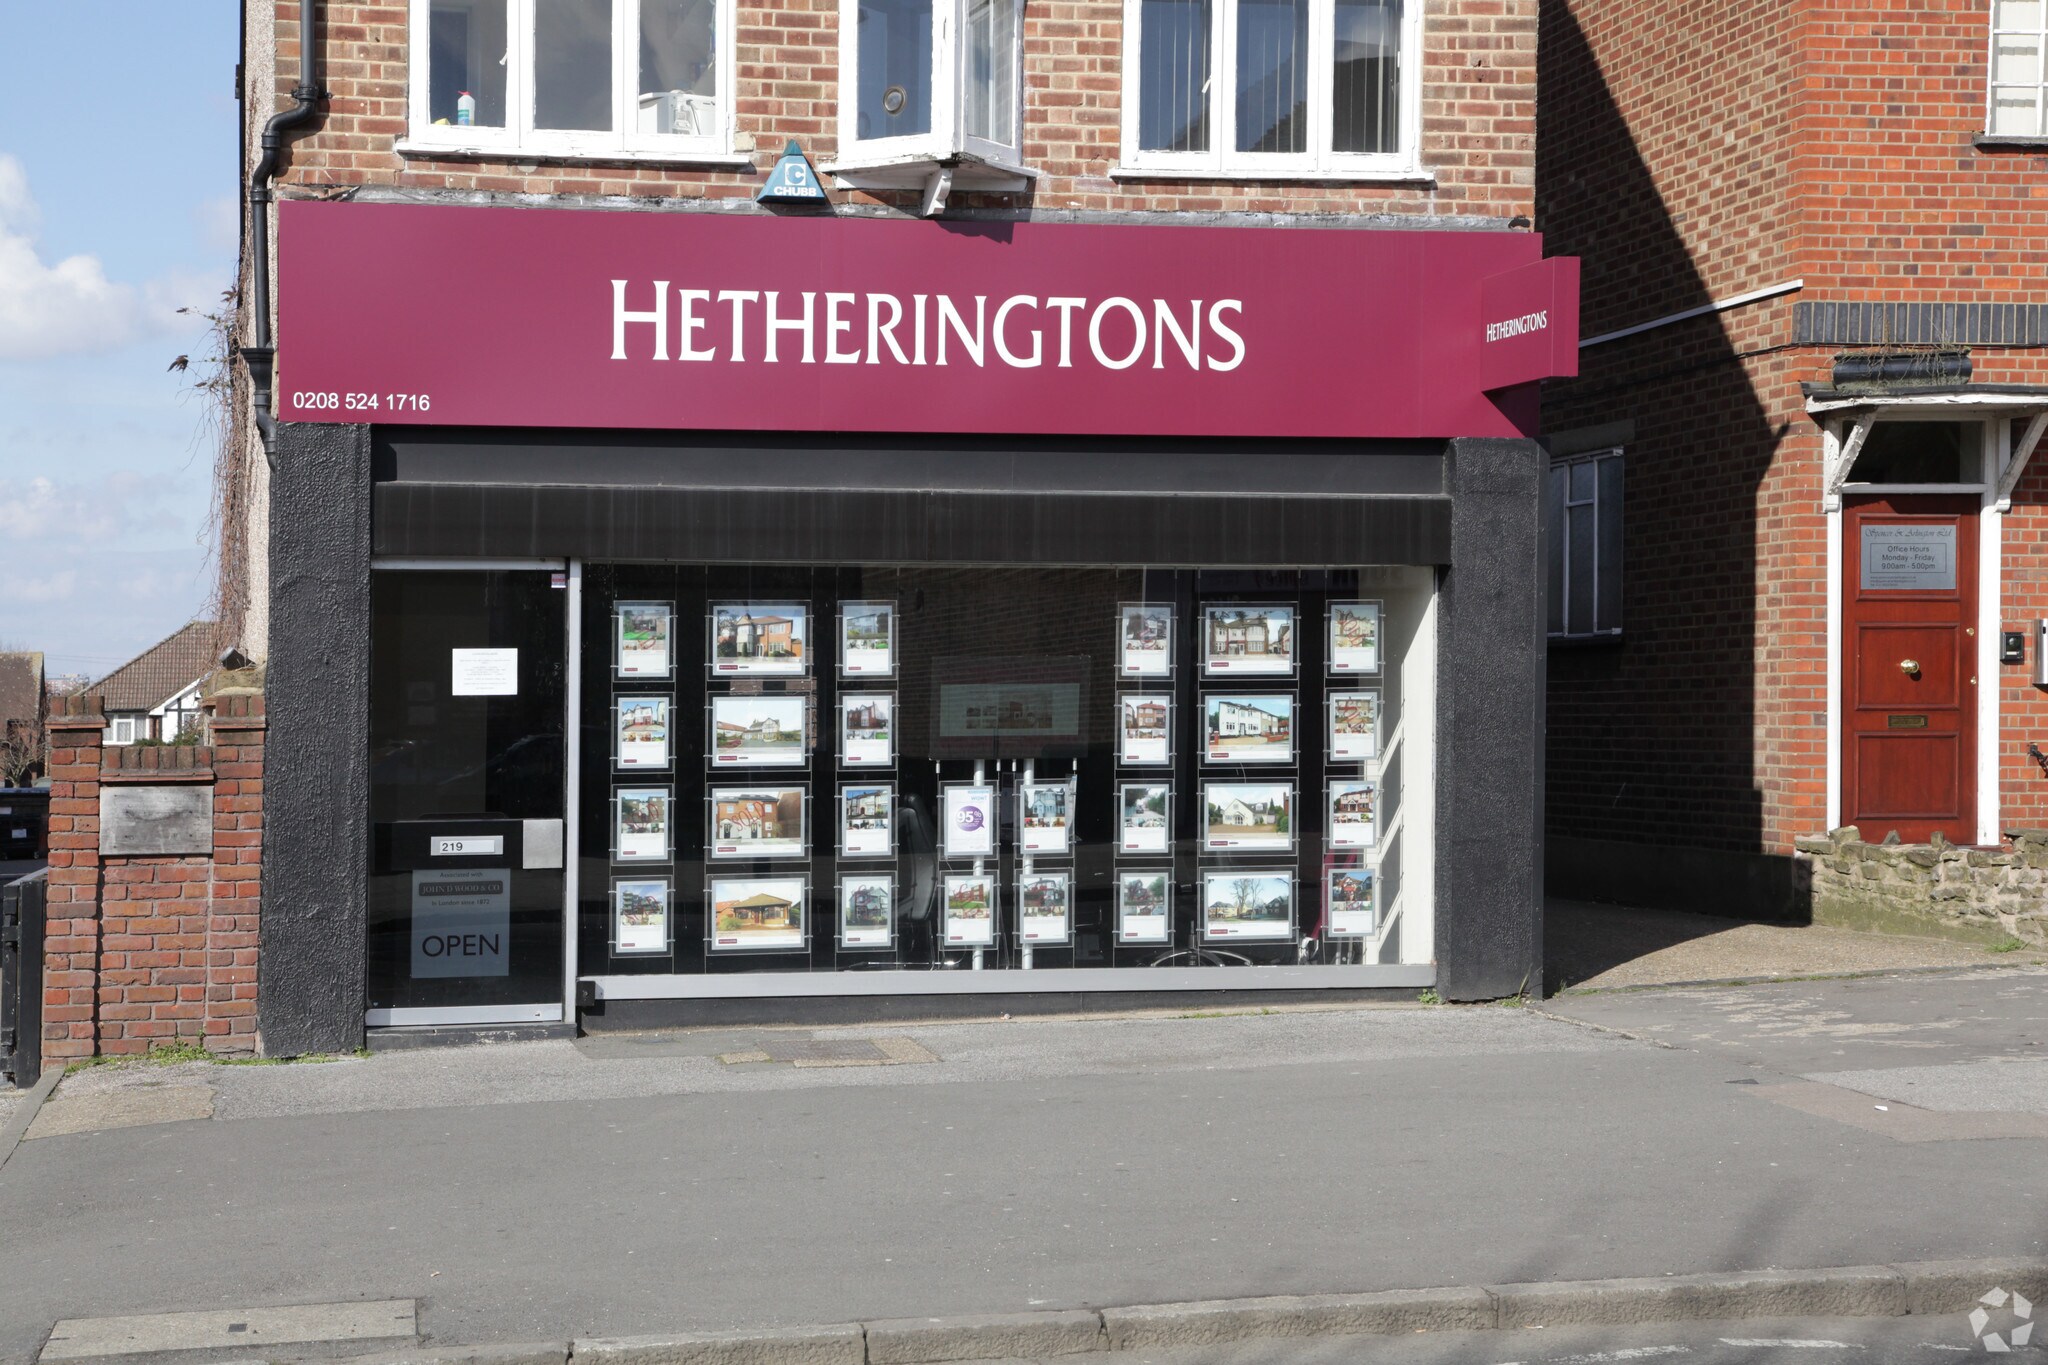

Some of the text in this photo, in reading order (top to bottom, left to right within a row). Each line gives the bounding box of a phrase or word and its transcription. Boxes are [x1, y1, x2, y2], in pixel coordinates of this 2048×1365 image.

[773, 186, 817, 197] CHUBB
[610, 279, 1246, 371] HETHERINGTONS
[1486, 310, 1547, 343] HETHERINGTONS
[293, 391, 431, 411] 0208 524 1716
[1887, 545, 1930, 553] Office Hours
[1881, 554, 1908, 562] Monday
[1914, 554, 1935, 562] Friday
[957, 810, 982, 823] 95%
[442, 841, 463, 852] 219
[422, 885, 445, 894] JOHN
[454, 884, 479, 892] WOOD
[422, 933, 500, 957] OPEN
